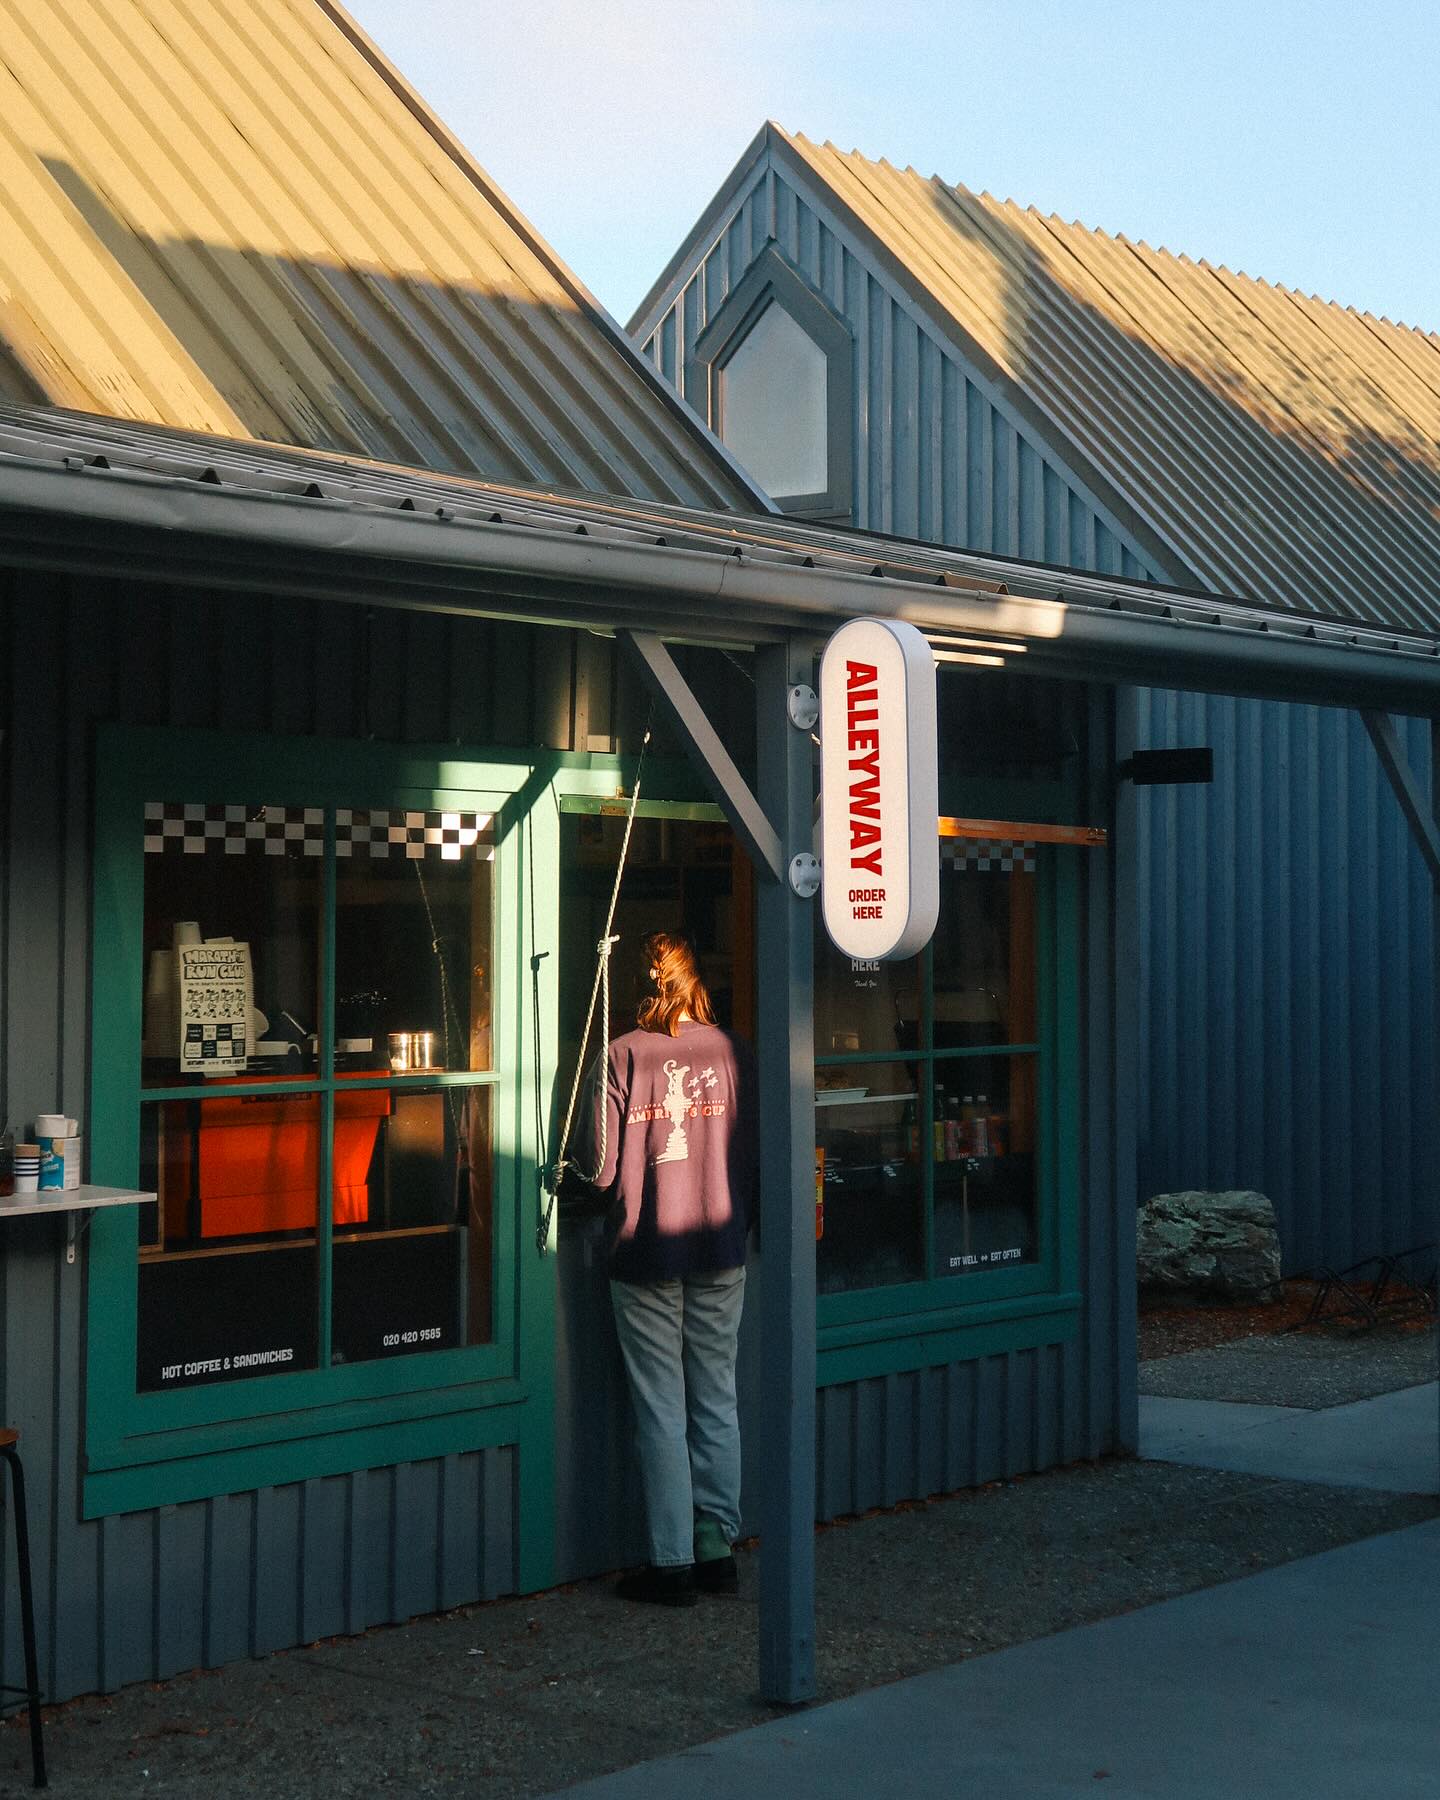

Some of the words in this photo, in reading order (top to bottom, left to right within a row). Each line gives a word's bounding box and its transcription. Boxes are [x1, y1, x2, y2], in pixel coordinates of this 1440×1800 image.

[846, 660, 883, 877] ALLEYWAY
[848, 889, 886, 902] ORDER
[853, 906, 883, 919] HERE
[184, 965, 217, 979] RUN
[218, 964, 246, 979] CLUB
[851, 959, 880, 972] HERE
[702, 1105, 725, 1117] CUP
[950, 1257, 961, 1267] EAT
[961, 1255, 978, 1265] WELL
[990, 1251, 1002, 1261] EAT
[1002, 1248, 1021, 1259] OFTEN
[383, 1334, 400, 1347] 020
[401, 1331, 418, 1344] 420
[419, 1328, 441, 1341] 9585
[162, 1364, 182, 1380] HOT
[184, 1359, 222, 1376] COFFEE
[223, 1357, 231, 1370] &
[233, 1348, 293, 1369] SANDWICHES
